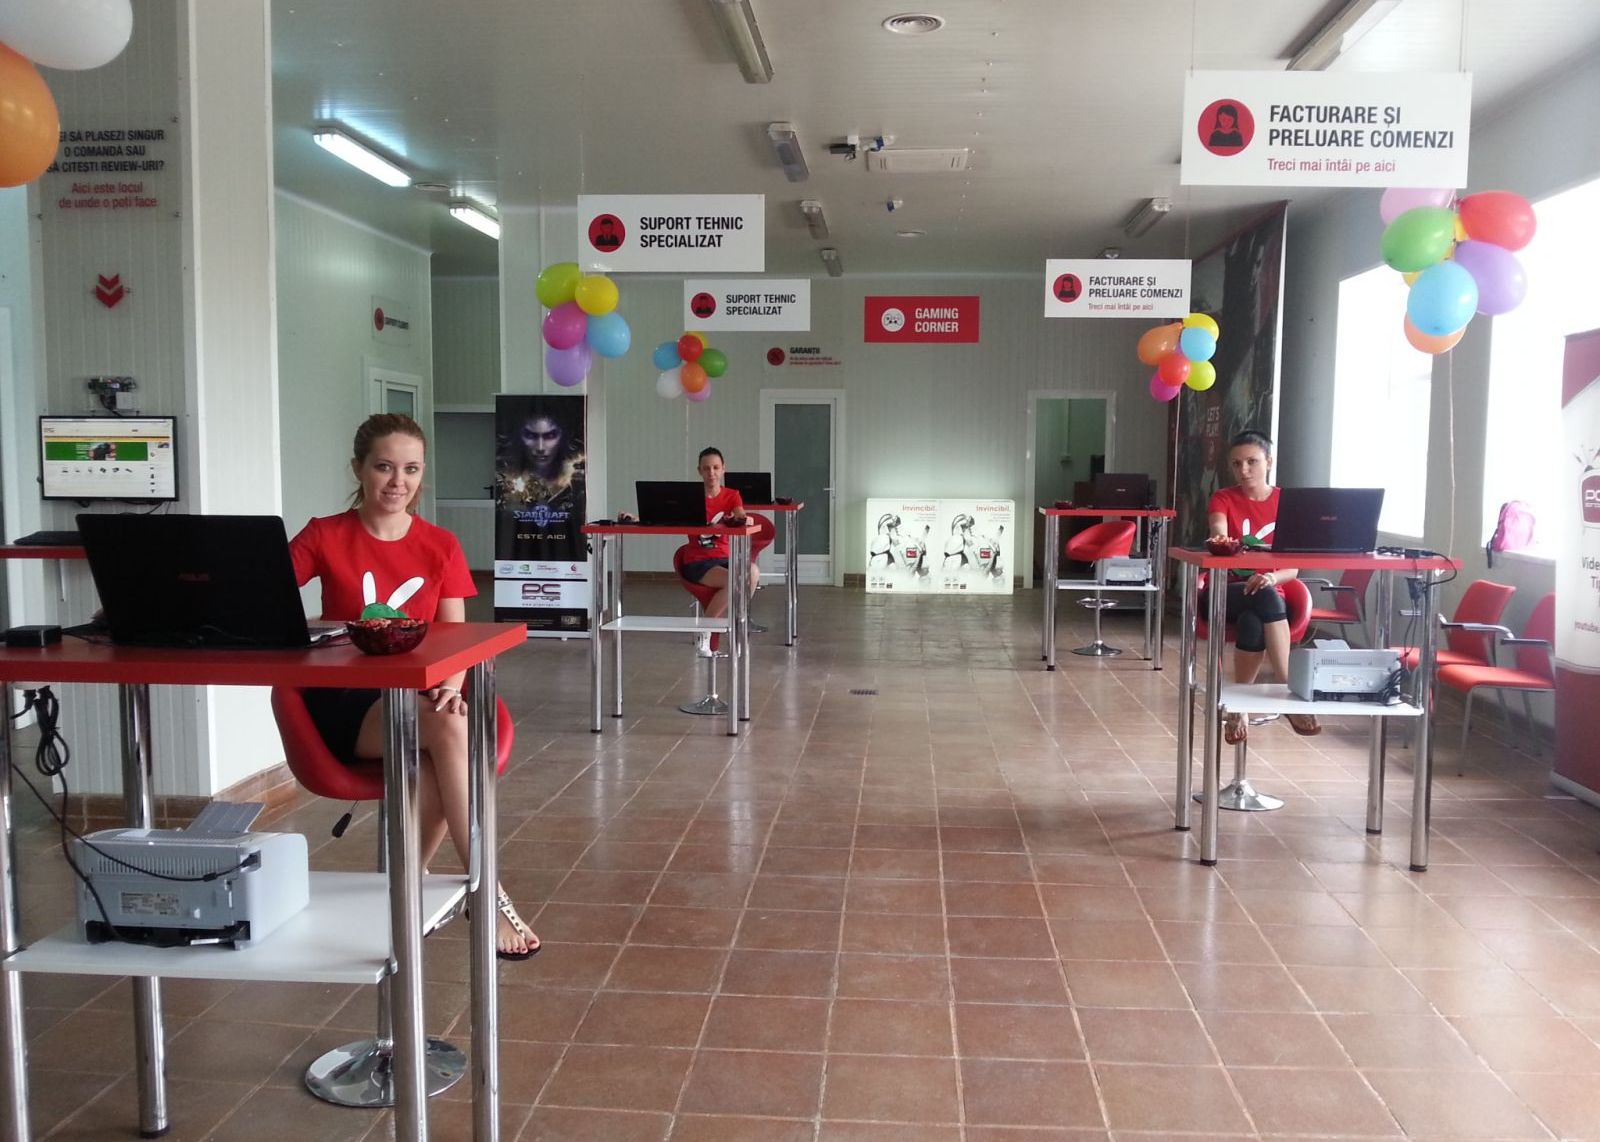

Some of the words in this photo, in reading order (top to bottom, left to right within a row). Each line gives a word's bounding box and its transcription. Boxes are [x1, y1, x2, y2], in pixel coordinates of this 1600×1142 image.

[1269, 104, 1378, 124] FACTURARE
[85, 130, 125, 141] PLASEZI
[127, 129, 165, 140] SINGUR
[1268, 128, 1364, 148] PRELUARE
[1370, 129, 1454, 149] COMENZI
[63, 146, 71, 157] O
[126, 145, 146, 156] SAU
[1267, 158, 1296, 171] Treci
[1300, 159, 1322, 171] mai
[1355, 162, 1371, 174] pe
[1374, 159, 1396, 172] aici
[94, 183, 115, 193] este
[640, 216, 692, 230] SUPORT
[695, 216, 743, 230] TEHNIC
[640, 234, 723, 248] SPECIALIZAT
[1089, 276, 1144, 286] FACTURARE
[726, 294, 761, 304] SUPORT
[764, 294, 796, 304] TEHNIC
[1088, 288, 1138, 298] PRELUARE
[1140, 288, 1183, 299] COMENZI
[726, 306, 782, 316] SPECIALIZAT
[915, 307, 959, 319] GAMING
[915, 321, 959, 333] CORNER
[522, 583, 561, 596] PC
